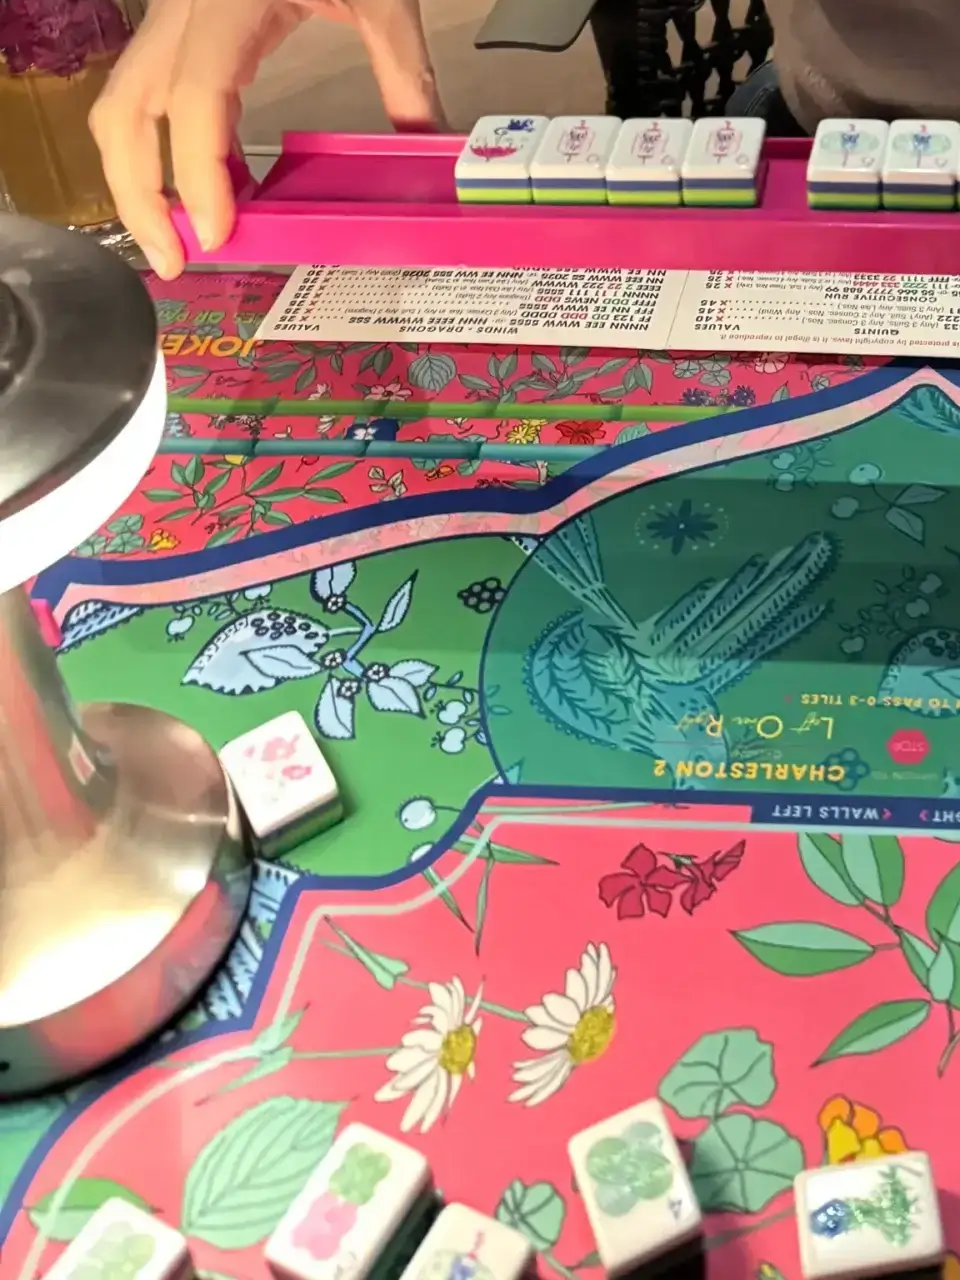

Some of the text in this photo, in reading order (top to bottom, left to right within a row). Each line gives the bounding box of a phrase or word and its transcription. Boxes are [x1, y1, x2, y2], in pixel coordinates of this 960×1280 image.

[636, 284, 661, 292] EEEE
[824, 292, 936, 303] CONSECUTIVE RUN
[602, 298, 629, 306] DDD
[551, 304, 588, 312] WWW
[373, 316, 424, 324] WWWW
[560, 312, 588, 320] DDD
[613, 314, 634, 322] 123
[542, 320, 580, 328] WWW
[610, 322, 648, 330] NNNN
[476, 326, 518, 334] WINDS
[854, 328, 899, 336] QUINTS
[729, 333, 772, 341] reproduce
[784, 334, 810, 342] illegal
[855, 337, 894, 345] copyright
[160, 334, 260, 358] JOKE
[801, 694, 842, 706] TILES
[850, 695, 876, 706] 0-3
[882, 696, 922, 708] PASS
[928, 698, 949, 708] TO
[732, 714, 783, 739] Over
[790, 712, 834, 740] Left
[653, 760, 846, 782] CHARLESTON 2
[772, 804, 879, 820] WALLS LEFT
